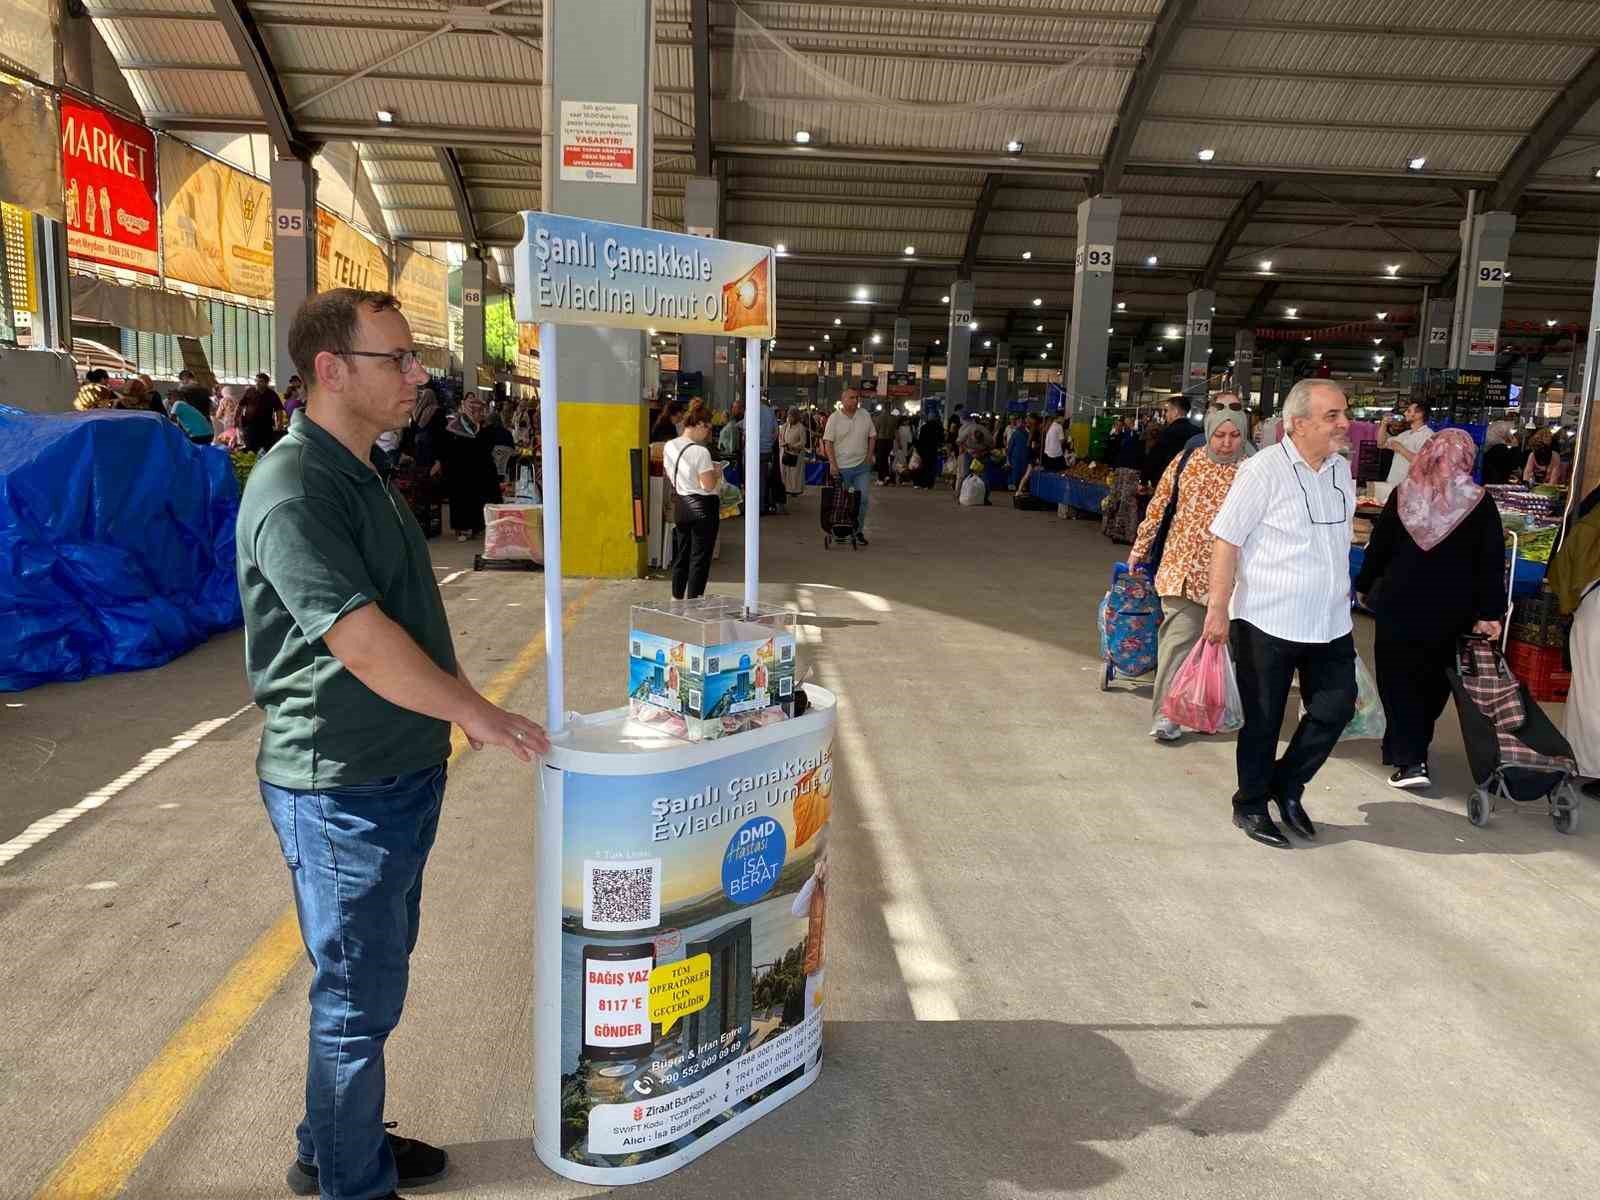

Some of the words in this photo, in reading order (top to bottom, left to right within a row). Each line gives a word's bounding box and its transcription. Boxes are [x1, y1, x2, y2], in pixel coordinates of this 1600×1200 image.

[63, 116, 147, 182] MARKET
[278, 215, 302, 230] 95
[535, 227, 597, 272] Şanlı
[603, 238, 713, 281] Çanakkale
[1089, 251, 1111, 265] 93
[1479, 267, 1502, 281] 92
[465, 293, 480, 302] 68
[538, 272, 635, 314] Evladına
[642, 285, 698, 320] Umut
[956, 313, 970, 323] 70
[1196, 322, 1209, 331] 71
[1431, 331, 1447, 340] 72
[651, 784, 720, 822] Şanlı
[728, 750, 832, 801] Çanakkale
[651, 799, 757, 841] Evladına
[766, 777, 819, 807] Umut
[740, 821, 776, 846] DMD
[743, 855, 766, 875] İSA
[730, 862, 778, 896] BERAT
[589, 971, 624, 986] BAĞIŞ
[627, 970, 649, 984] YAZ
[672, 965, 690, 977] TÜM
[650, 970, 710, 995] OPERATÖRLER
[598, 999, 628, 1011] 8117
[594, 1023, 642, 1038] GÖNDER
[687, 1049, 695, 1059] &
[682, 1063, 700, 1078] 552
[646, 1101, 674, 1117] Ziraat
[675, 1088, 706, 1108] Bankası
[613, 1125, 642, 1135] SWIFT
[622, 1136, 646, 1146] Alıcı
[670, 1119, 692, 1134] Berat
